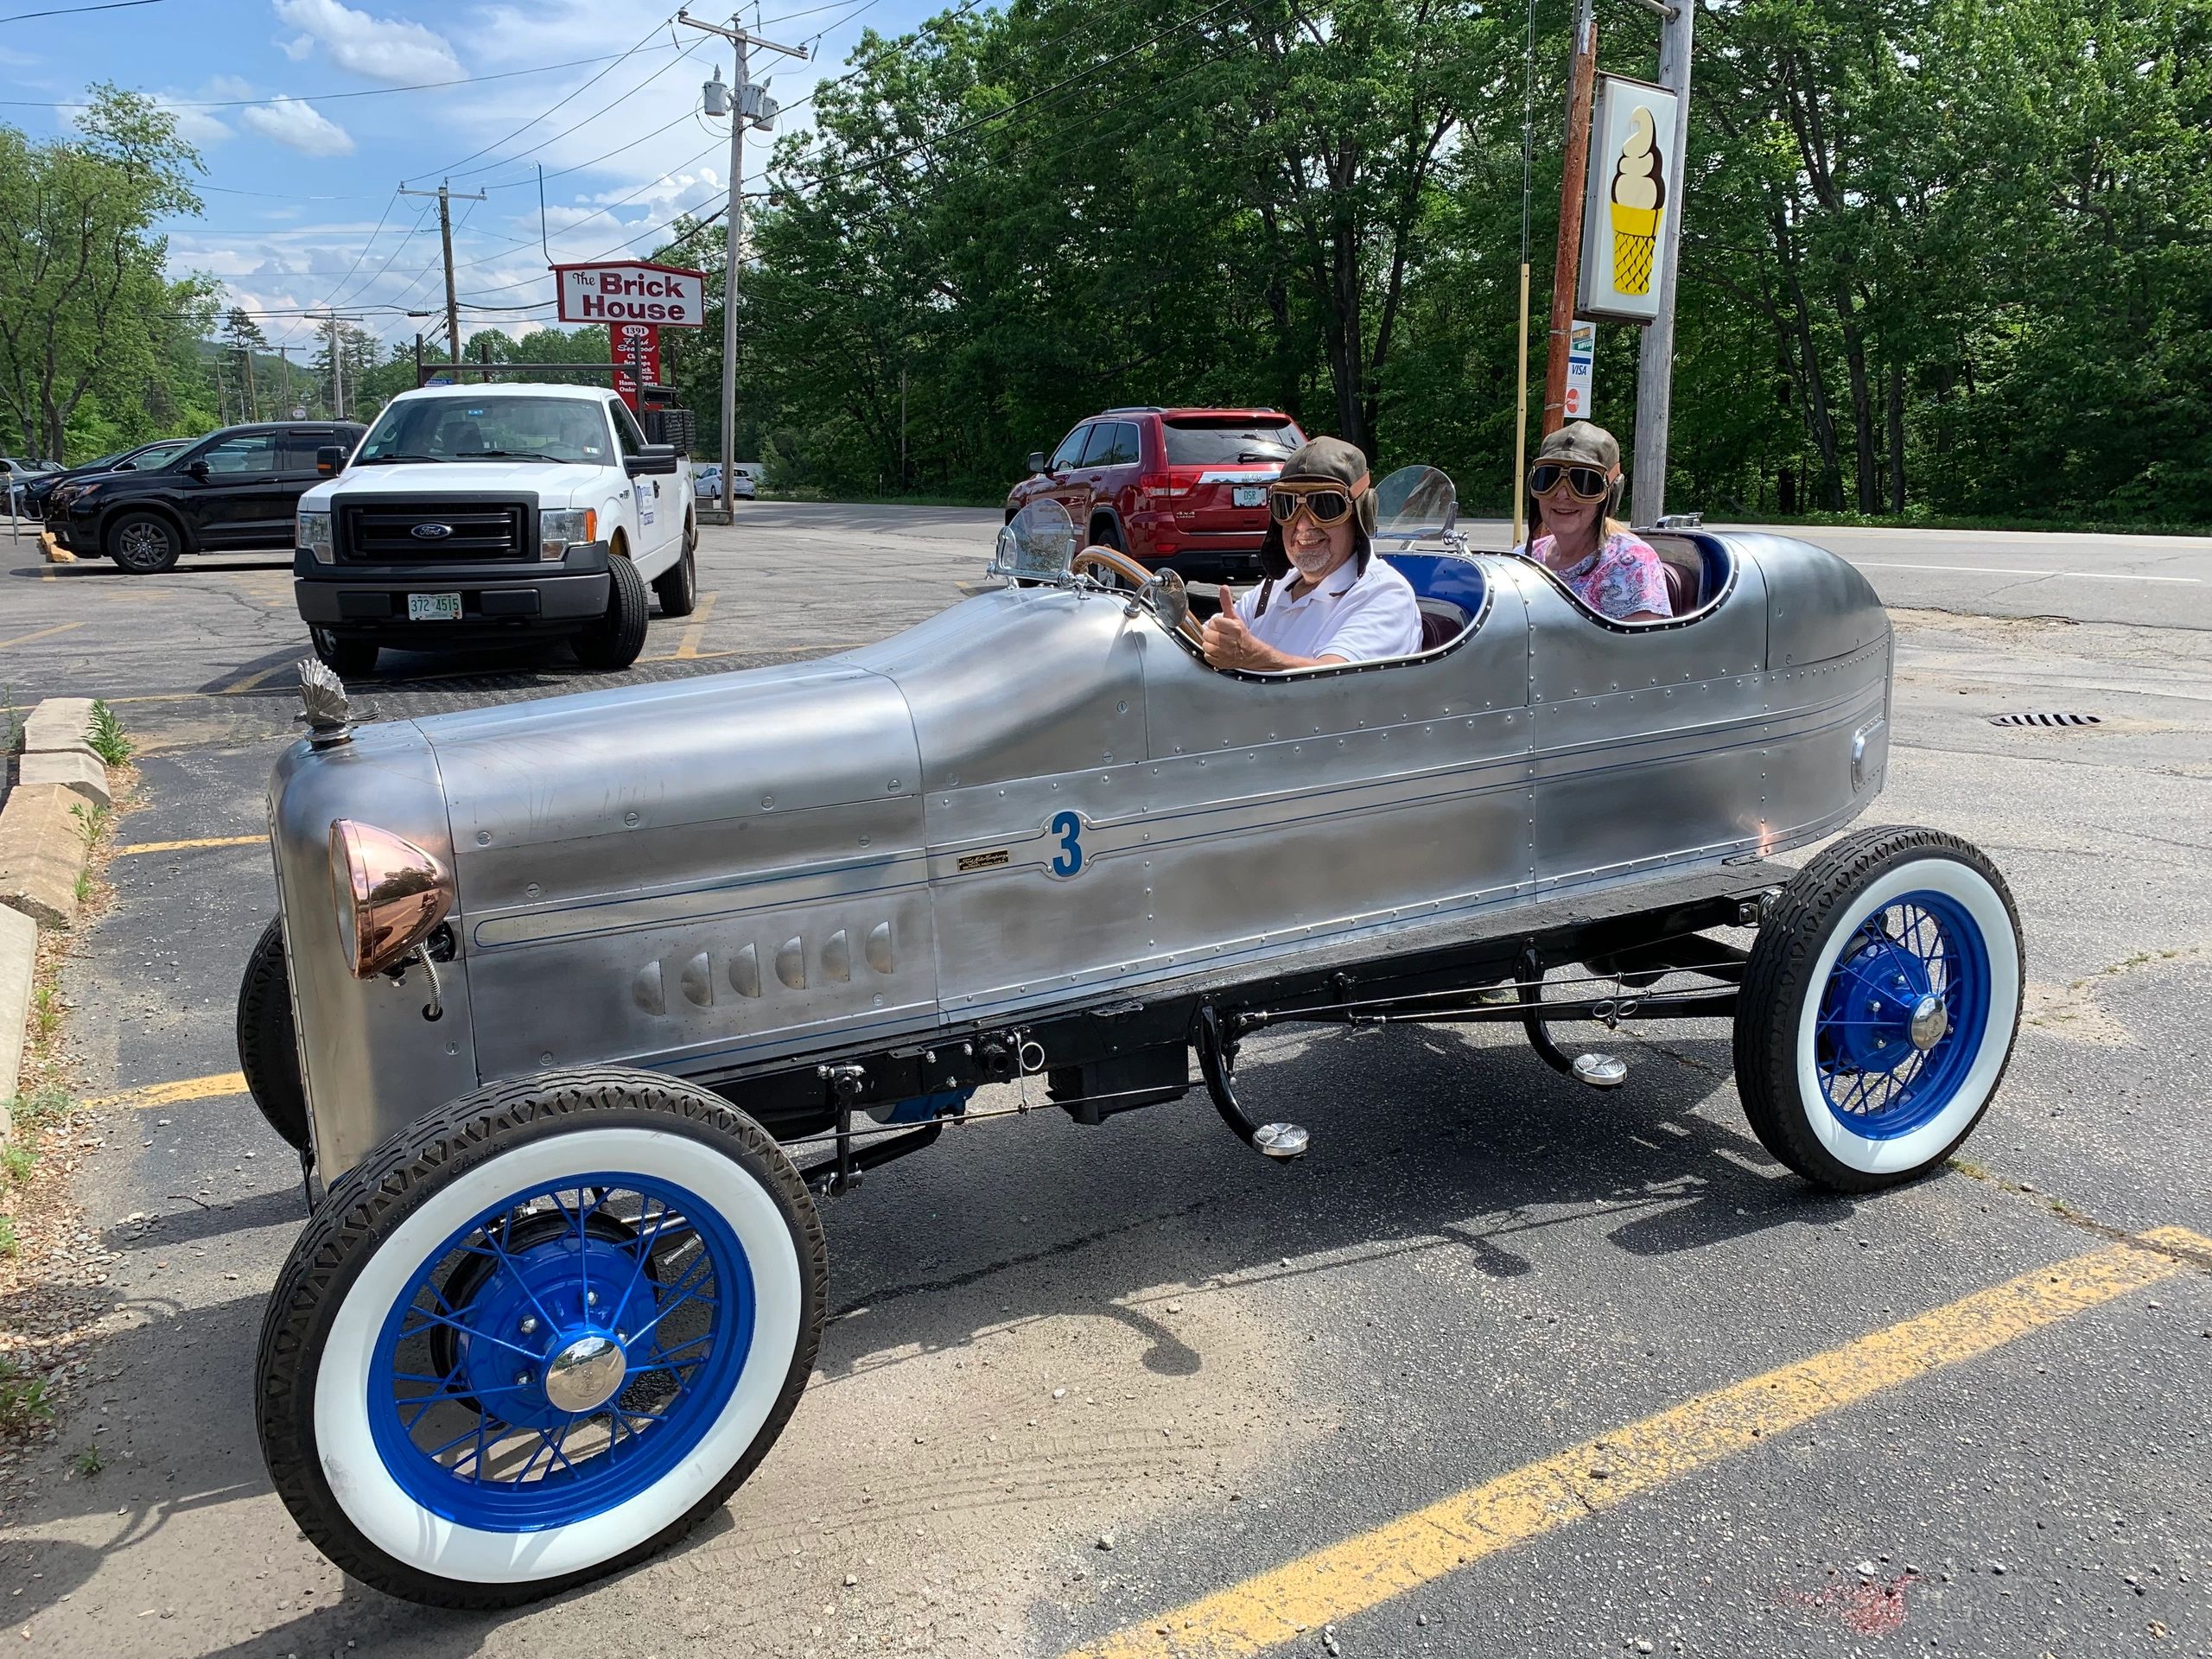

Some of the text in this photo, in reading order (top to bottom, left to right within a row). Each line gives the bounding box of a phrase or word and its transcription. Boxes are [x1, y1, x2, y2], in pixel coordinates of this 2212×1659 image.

[573, 271, 684, 298] The Brick
[582, 295, 685, 321] House
[1572, 364, 1587, 376] VISA
[420, 525, 442, 536] Ford
[410, 599, 460, 613] 372 4515
[1052, 810, 1083, 878] 3
